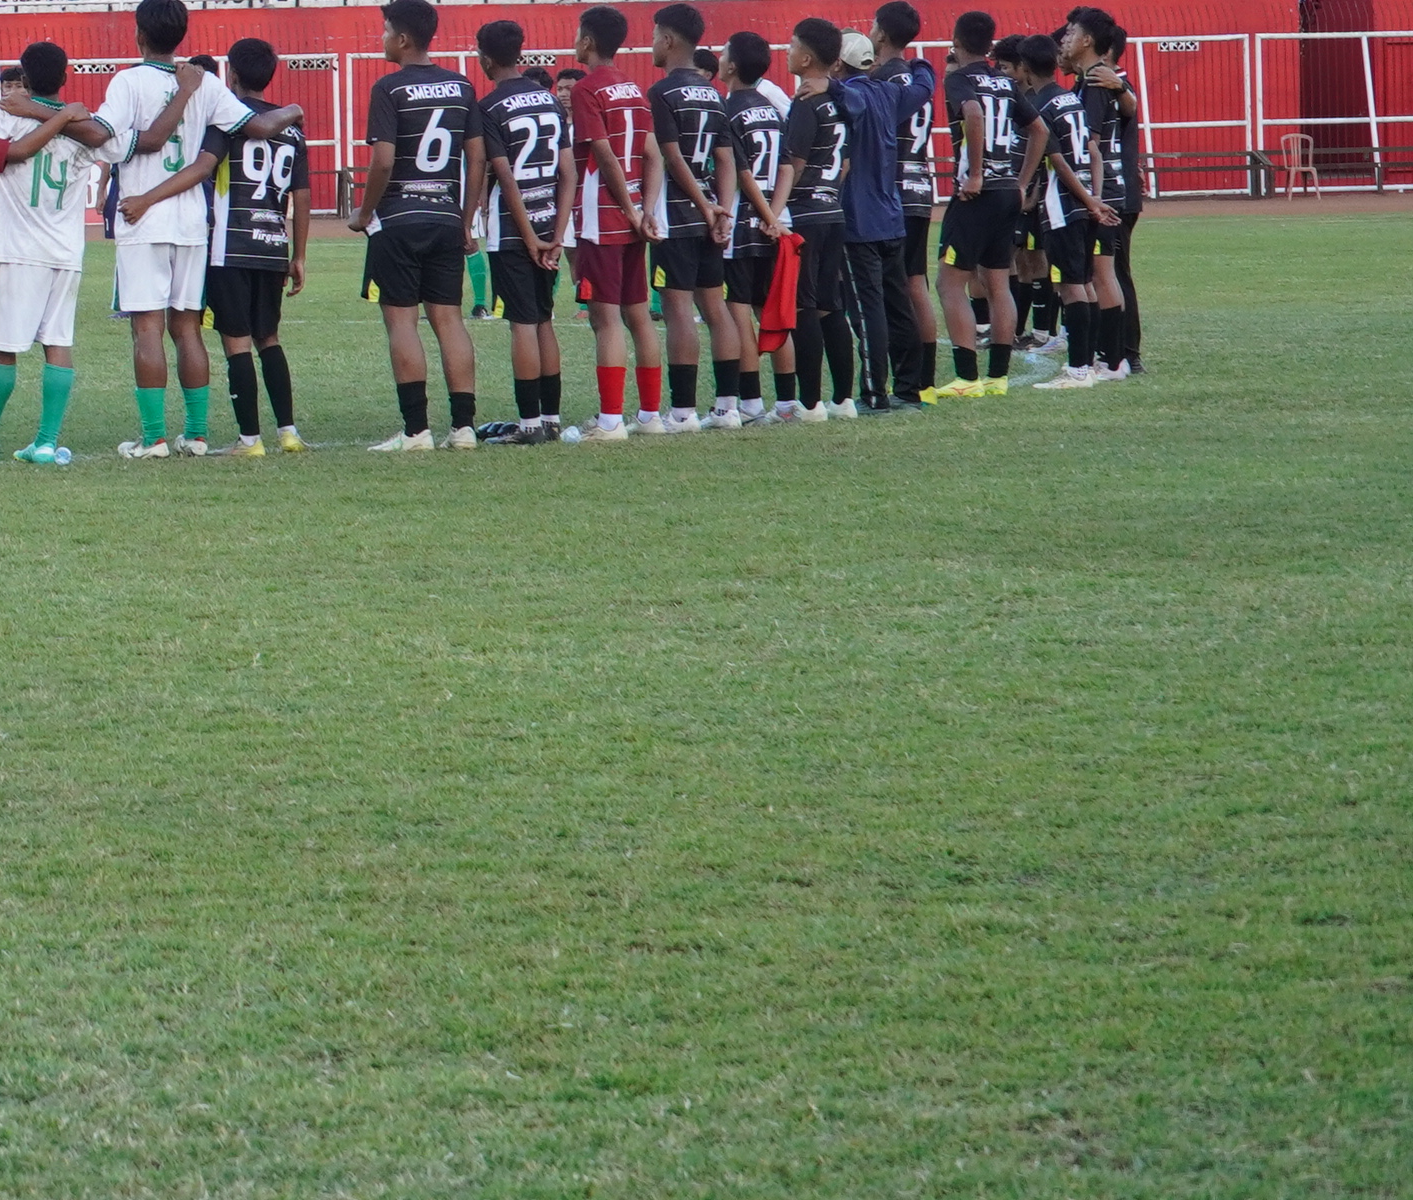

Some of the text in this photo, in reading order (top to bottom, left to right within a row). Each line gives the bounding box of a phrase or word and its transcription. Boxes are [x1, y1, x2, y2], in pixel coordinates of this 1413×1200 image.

[406, 83, 462, 101] SMEKENSA
[414, 107, 453, 173] 6
[508, 112, 562, 181] 23
[623, 109, 634, 173] 1
[691, 110, 713, 171] 4
[820, 123, 846, 181] 3
[981, 95, 1012, 154] 14
[30, 150, 68, 210] 14
[241, 138, 296, 204] 99
[752, 129, 781, 191] 21
